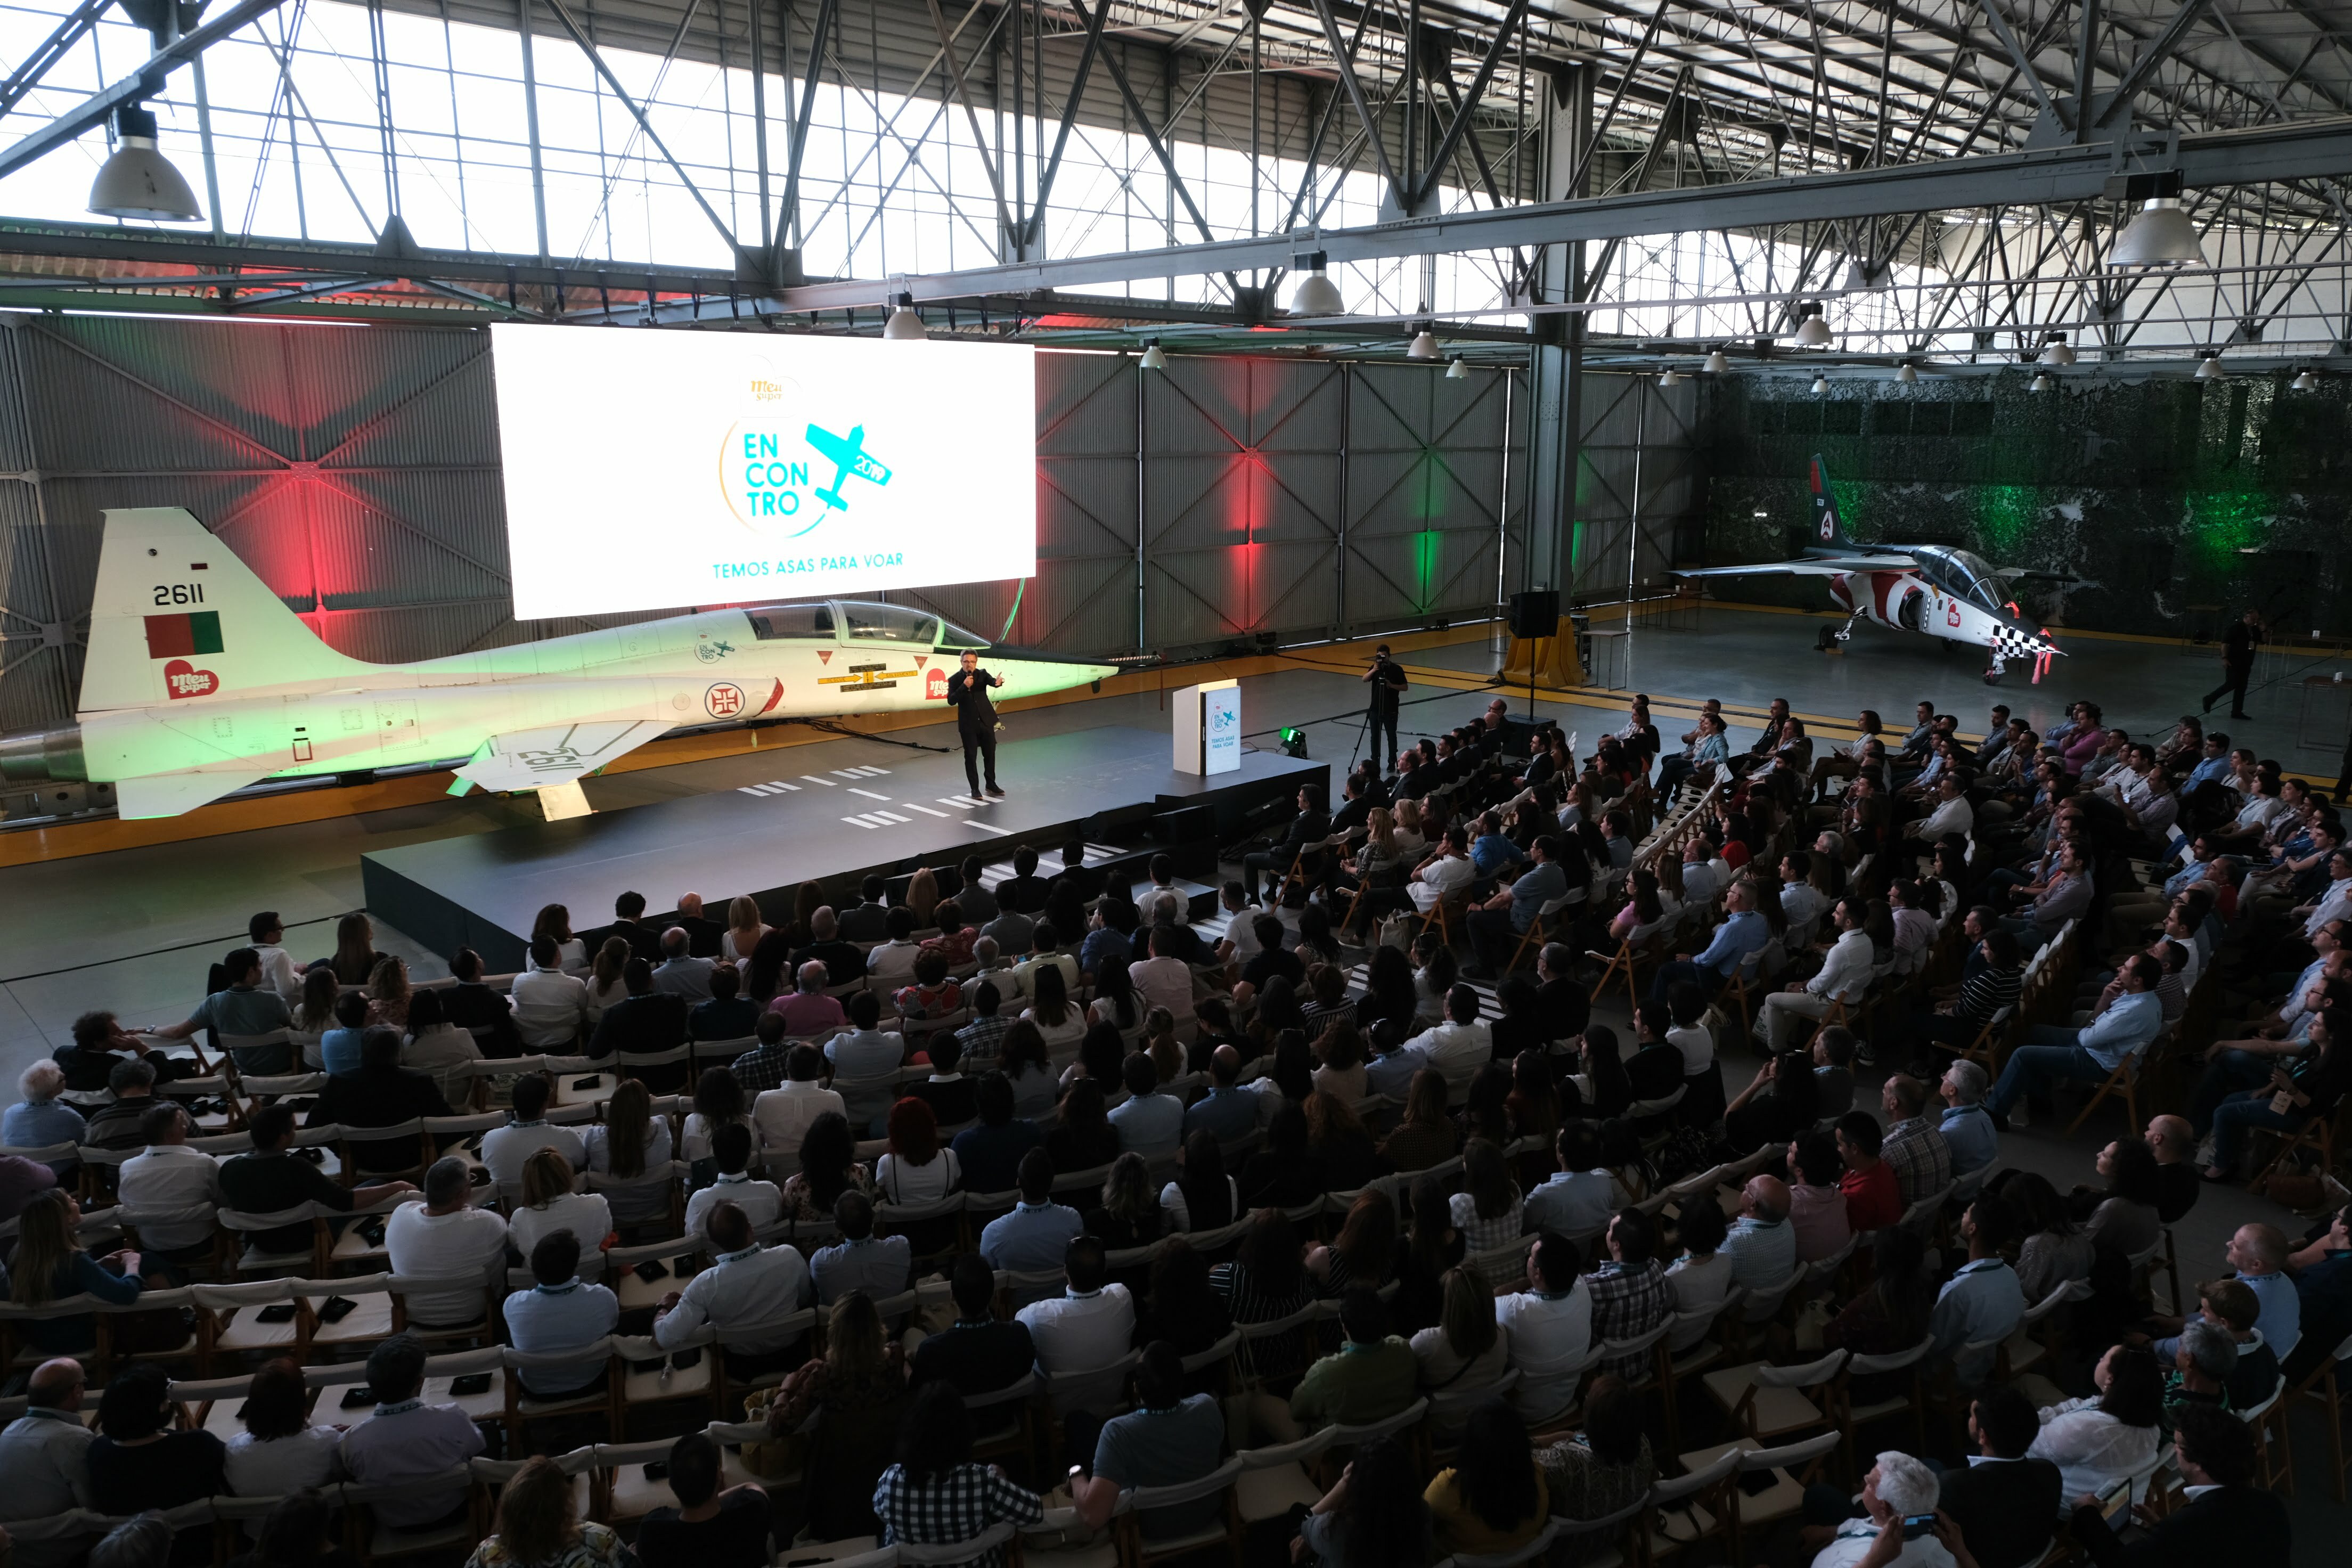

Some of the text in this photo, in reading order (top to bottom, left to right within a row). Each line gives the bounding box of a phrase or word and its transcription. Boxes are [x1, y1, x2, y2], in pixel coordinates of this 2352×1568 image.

[745, 433, 778, 459] EN
[746, 462, 808, 488] CON
[747, 491, 799, 517] TRO
[713, 552, 903, 578] TEMOS ASAS PARA VOAR
[153, 583, 204, 606] 2611
[179, 681, 211, 693] super
[517, 748, 584, 772] 2611
